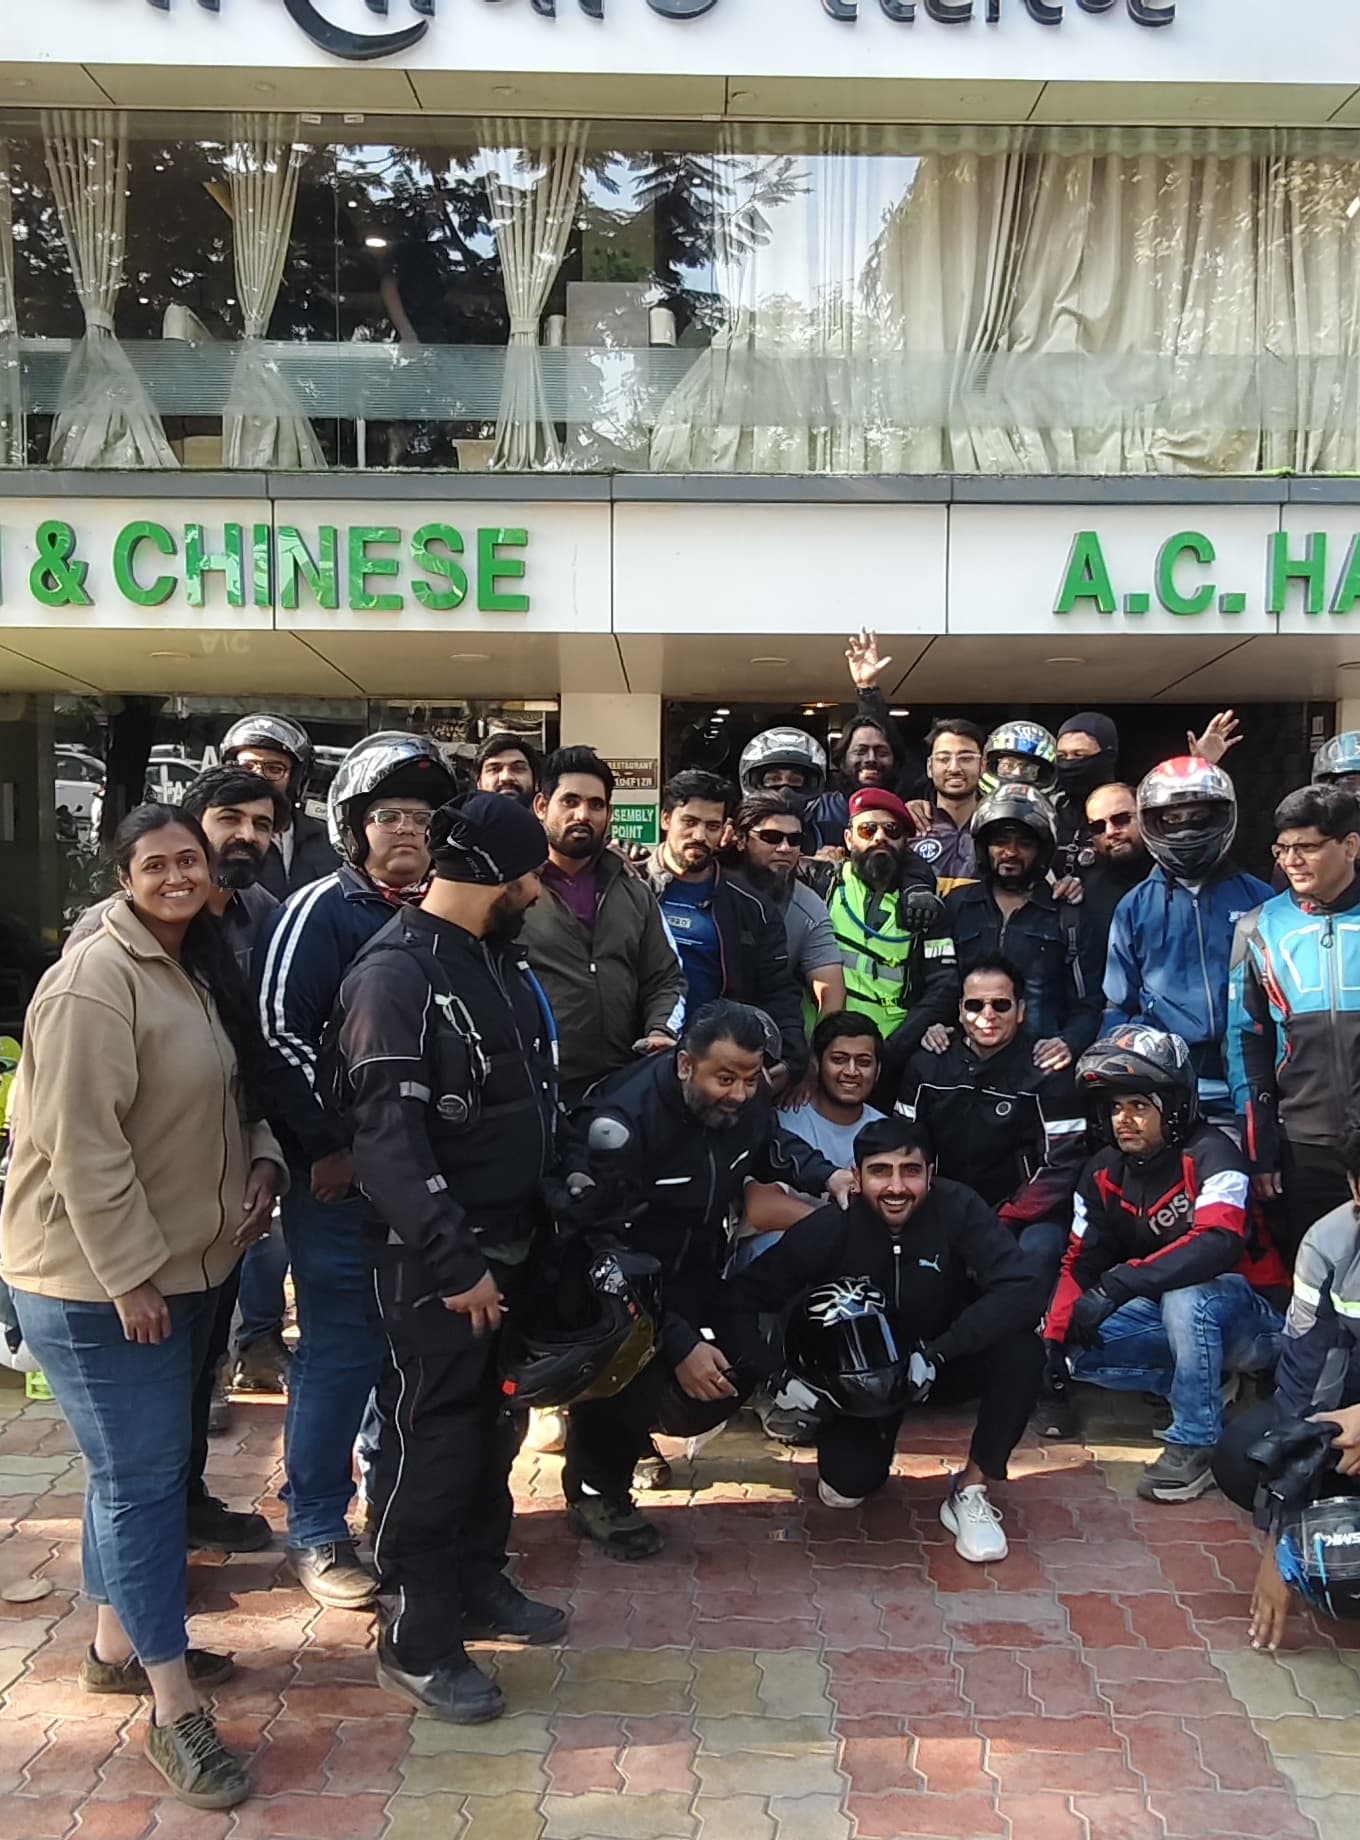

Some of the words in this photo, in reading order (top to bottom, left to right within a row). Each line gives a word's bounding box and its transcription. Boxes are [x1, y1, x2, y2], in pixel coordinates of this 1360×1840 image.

[39, 520, 94, 608] &
[113, 521, 530, 613] CHINESE
[1053, 530, 1248, 617] A.C.
[611, 824, 643, 839] POINT
[1148, 1186, 1190, 1236] reis
